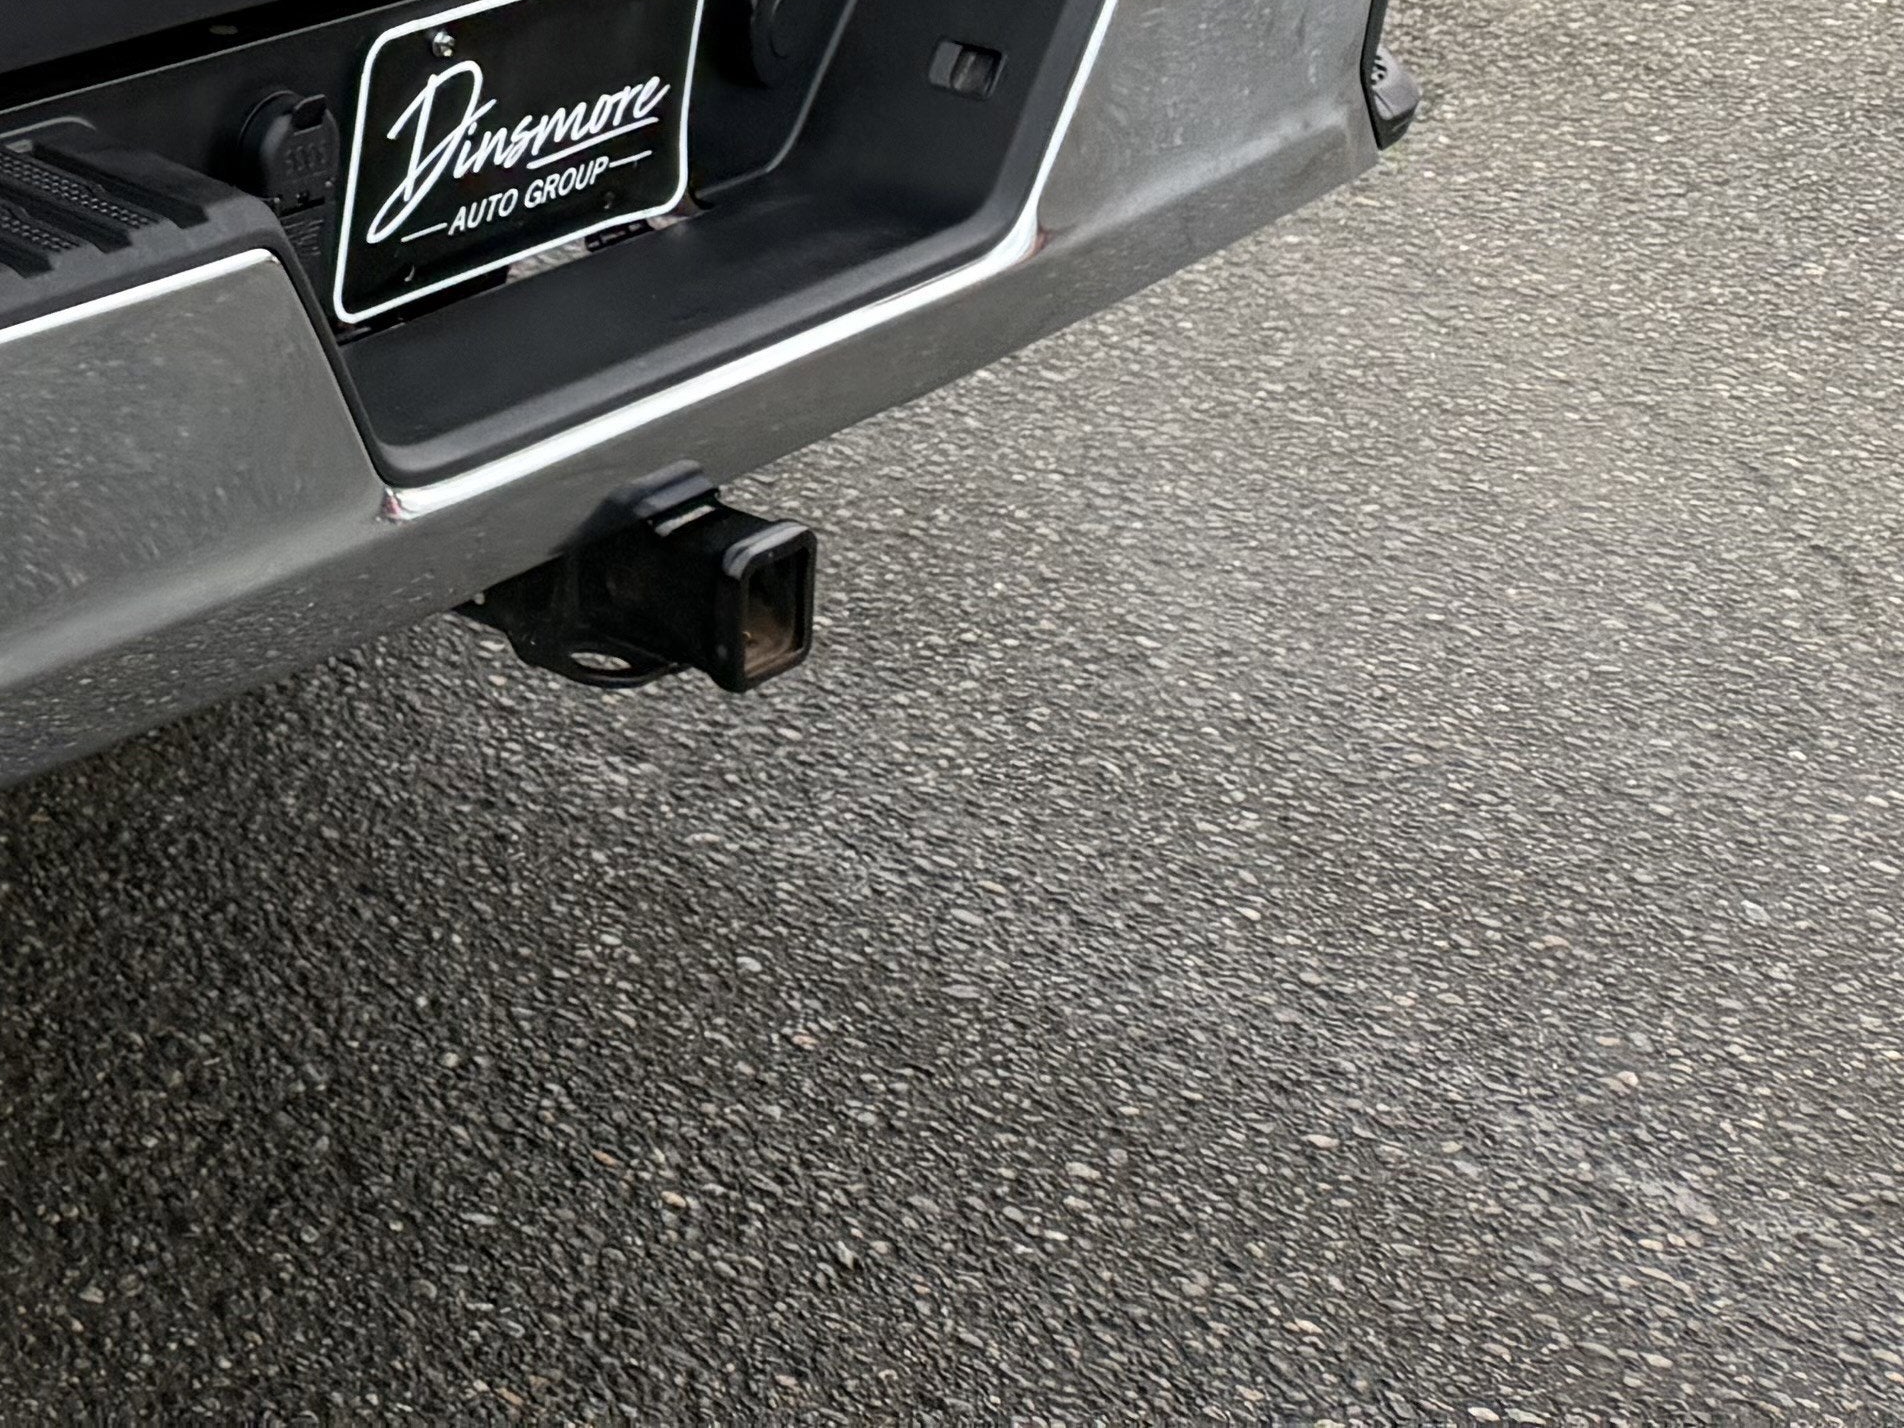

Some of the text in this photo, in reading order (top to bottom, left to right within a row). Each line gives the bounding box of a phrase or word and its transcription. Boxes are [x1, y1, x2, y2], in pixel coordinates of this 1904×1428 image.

[366, 60, 672, 245] Dinsmore
[448, 155, 610, 237] AUTO GROUP
